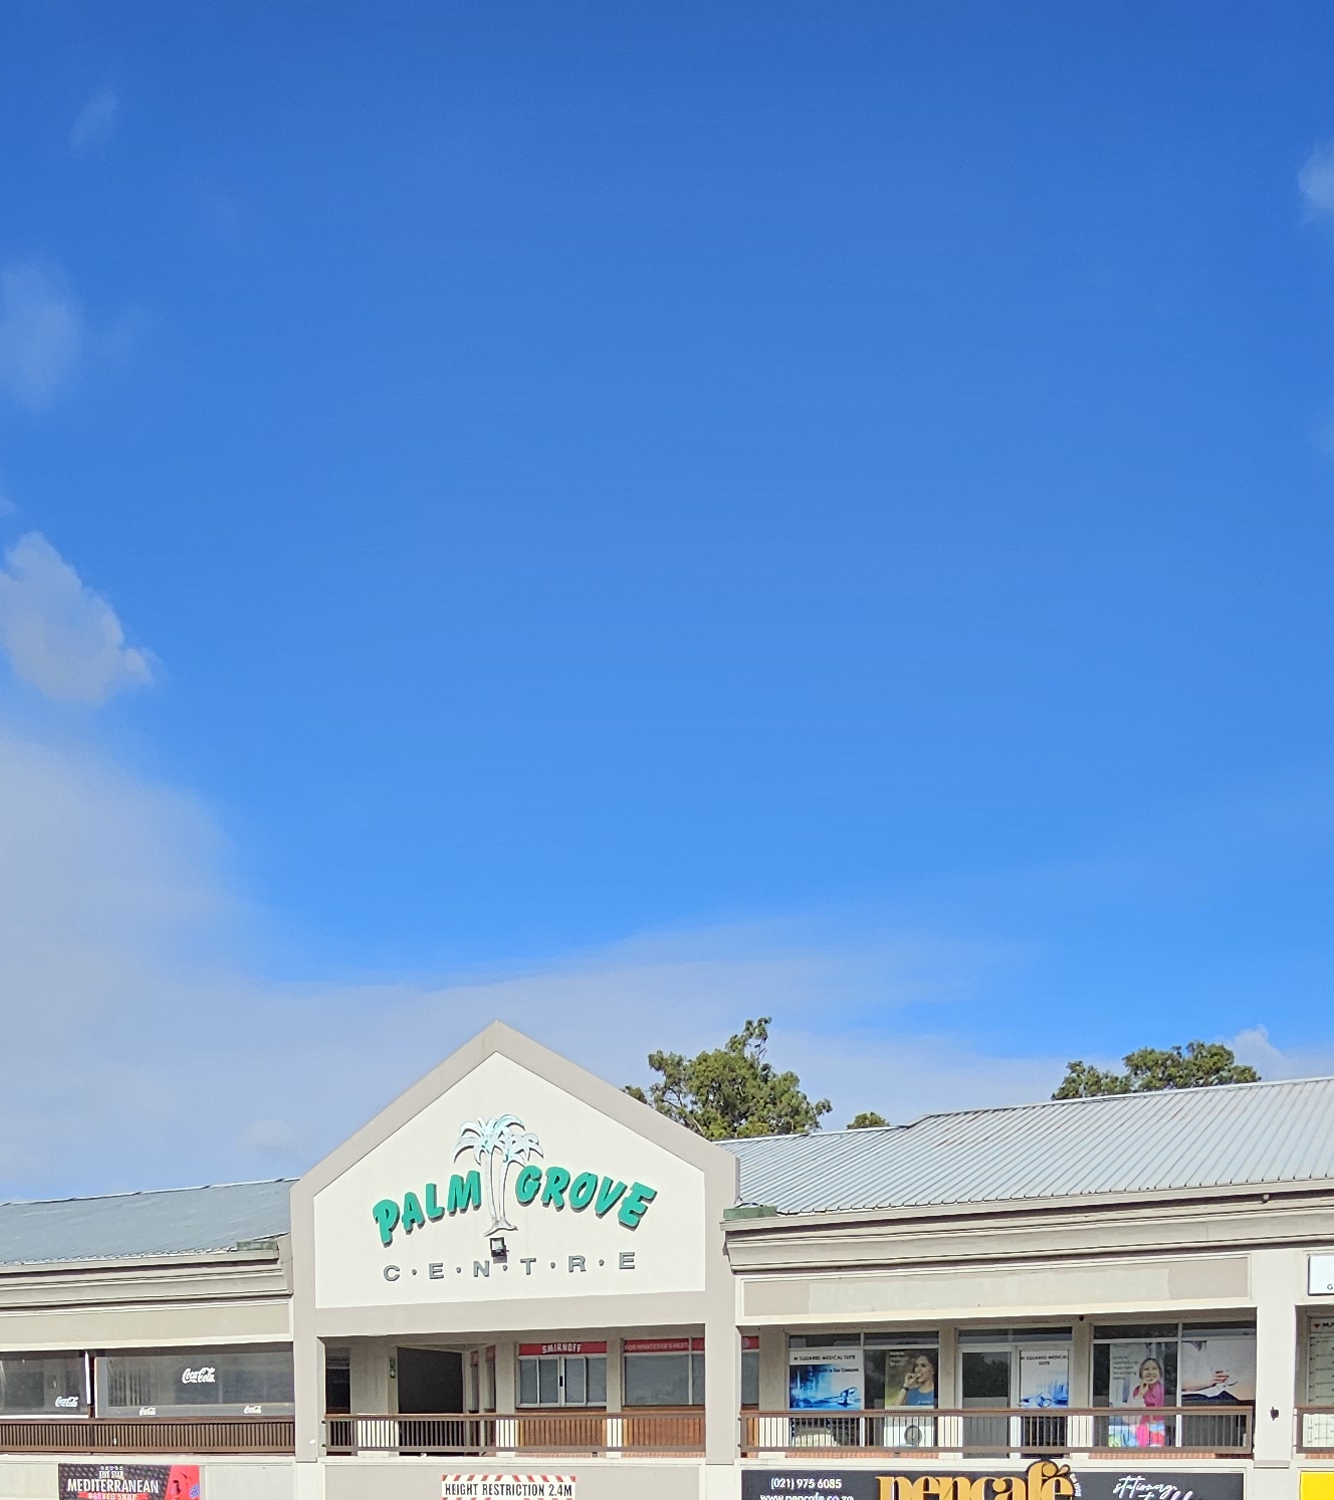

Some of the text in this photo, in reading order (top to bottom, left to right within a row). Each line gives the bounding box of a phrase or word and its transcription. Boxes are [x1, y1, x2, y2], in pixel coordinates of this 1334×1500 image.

[373, 1165, 658, 1247] PALM GROVE
[542, 1344, 582, 1353] SMIRNOFF
[182, 1367, 216, 1384] Coca-Cola
[67, 1478, 159, 1493] MEDITERRANEAN
[445, 1483, 572, 1497] HEIGHT RESTRICTION 2.4M
[770, 1478, 842, 1490] (021) 975 6085
